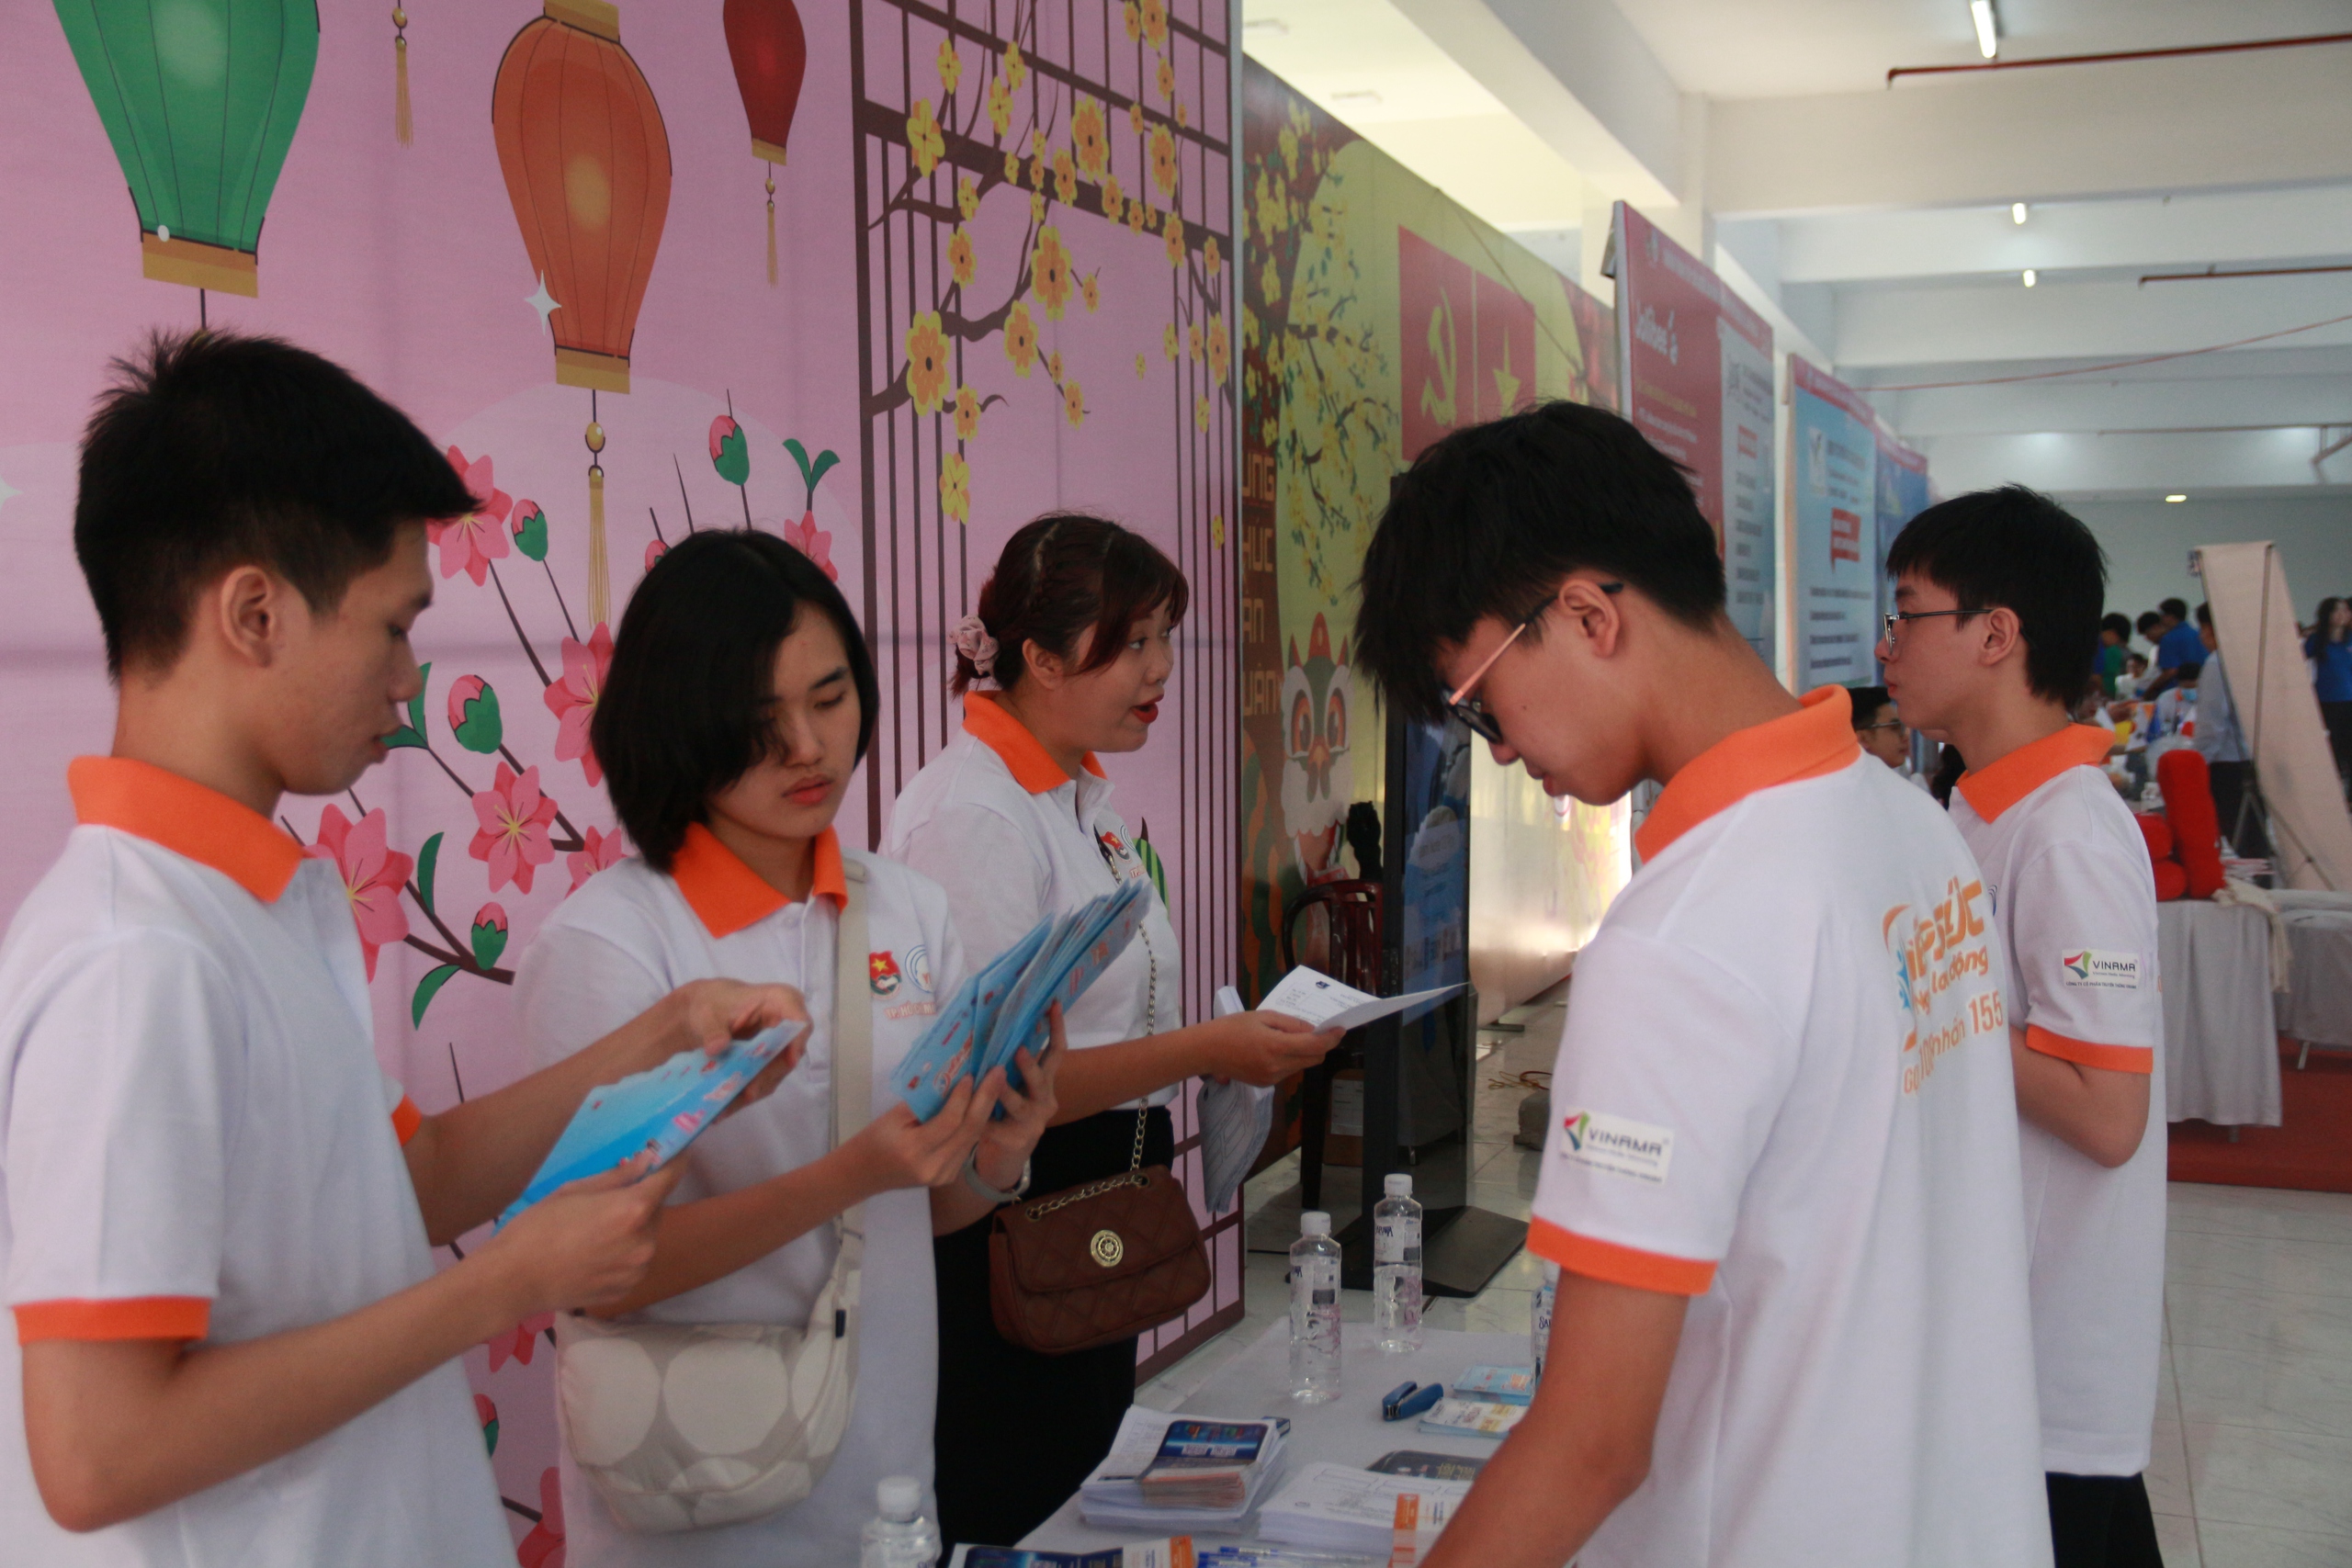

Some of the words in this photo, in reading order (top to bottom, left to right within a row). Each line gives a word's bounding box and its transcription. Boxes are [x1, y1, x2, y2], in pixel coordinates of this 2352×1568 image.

[1242, 451, 1275, 502] UNG
[1242, 516, 1273, 572] HÚC
[1242, 589, 1265, 643] ÂN
[1242, 662, 1277, 716] UÂN
[2092, 960, 2136, 972] VINAMA
[1968, 990, 2005, 1034] 155
[1589, 1127, 1662, 1156] VINAMA
